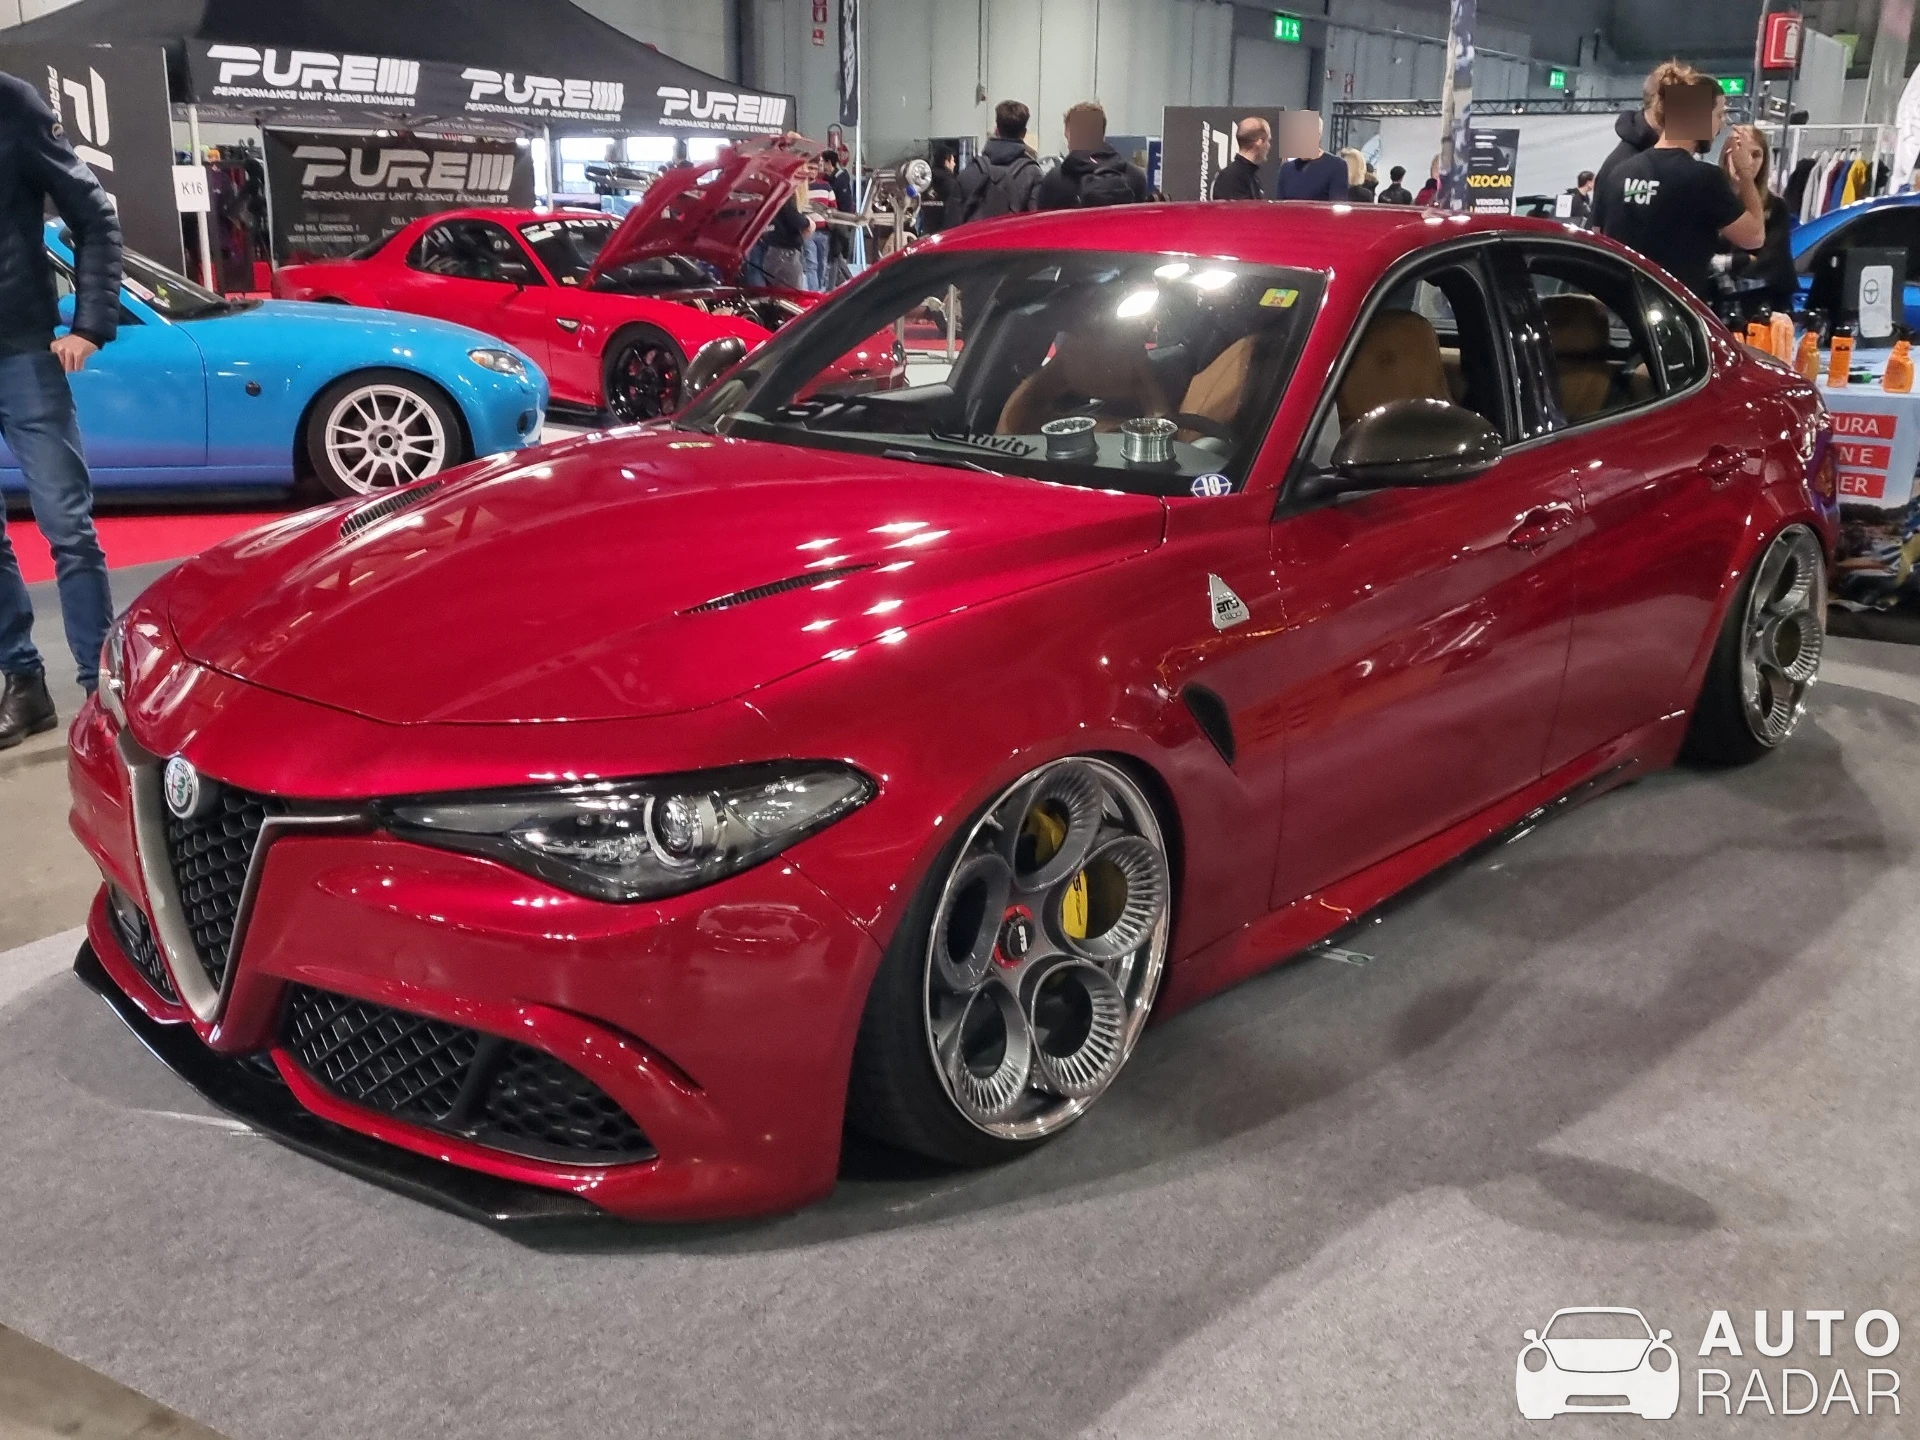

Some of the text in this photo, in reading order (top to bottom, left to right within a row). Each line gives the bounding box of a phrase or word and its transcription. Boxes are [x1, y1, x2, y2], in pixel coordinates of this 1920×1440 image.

[212, 86, 416, 107] PERFORMANCE UNIT RACING EXHAUSTS
[464, 102, 531, 115] PERFORMANCE
[531, 107, 549, 117] UNIT
[550, 109, 580, 119] RACING
[659, 117, 710, 128] PERFORMANCE
[710, 121, 726, 130] UNIT
[726, 122, 749, 132] RACING
[181, 181, 204, 195] K16
[301, 190, 387, 201] PERFORMANCE
[388, 193, 414, 201] UNIT
[415, 193, 451, 202] RACING
[1831, 416, 1879, 435] URA
[1200, 476, 1221, 497] 10
